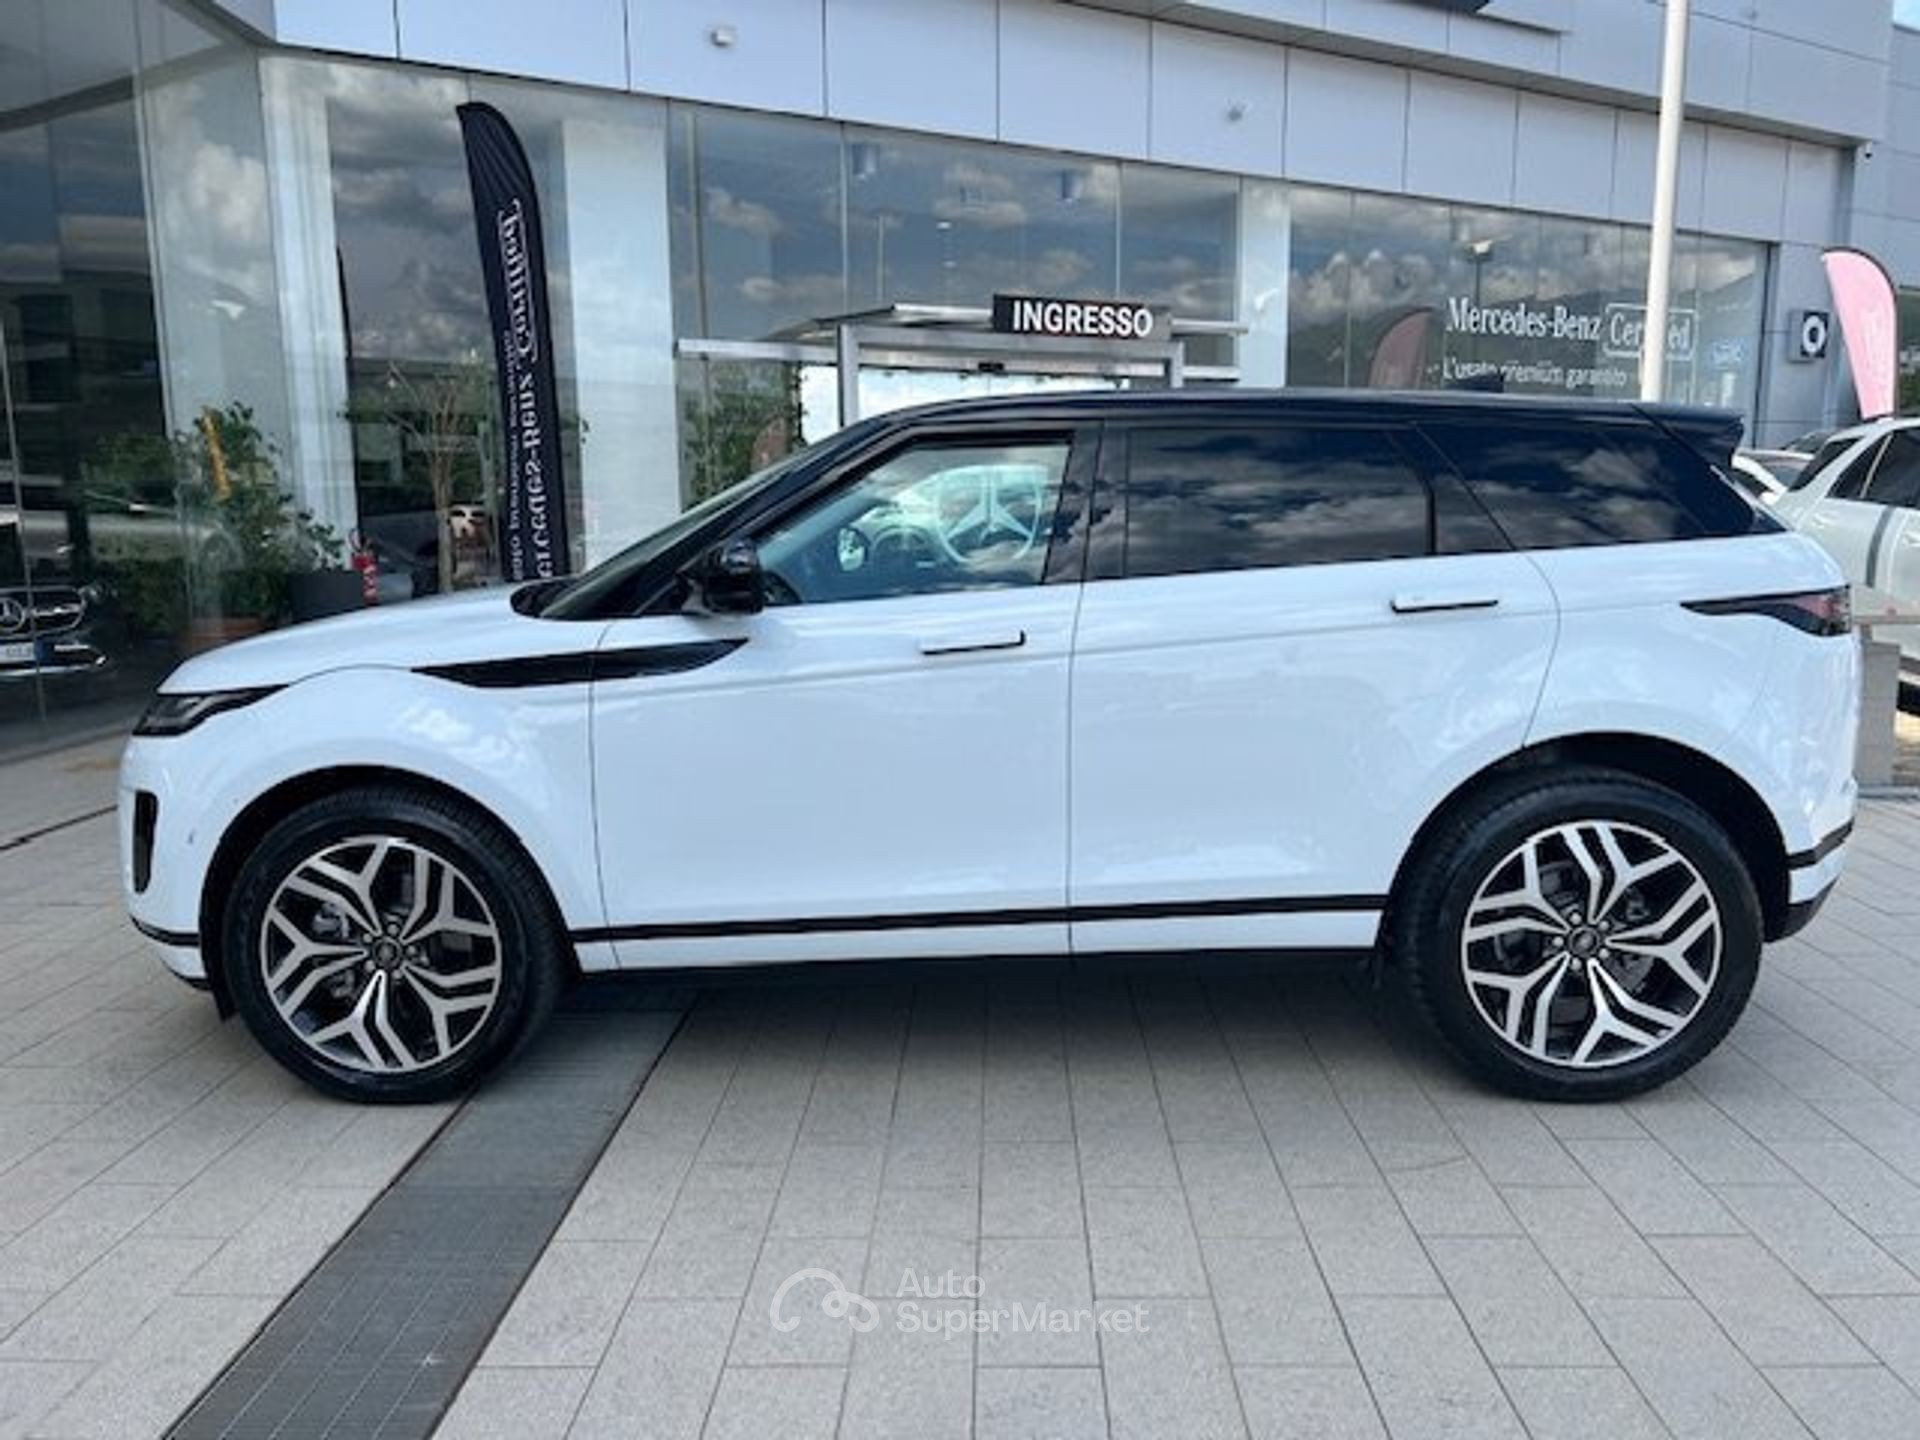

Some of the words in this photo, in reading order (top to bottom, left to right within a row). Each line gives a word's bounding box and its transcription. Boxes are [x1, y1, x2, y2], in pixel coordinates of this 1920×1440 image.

[1013, 300, 1153, 338] INGRESSO
[1446, 297, 1601, 340] Mercedes-Benz
[1611, 312, 1690, 350] Cered
